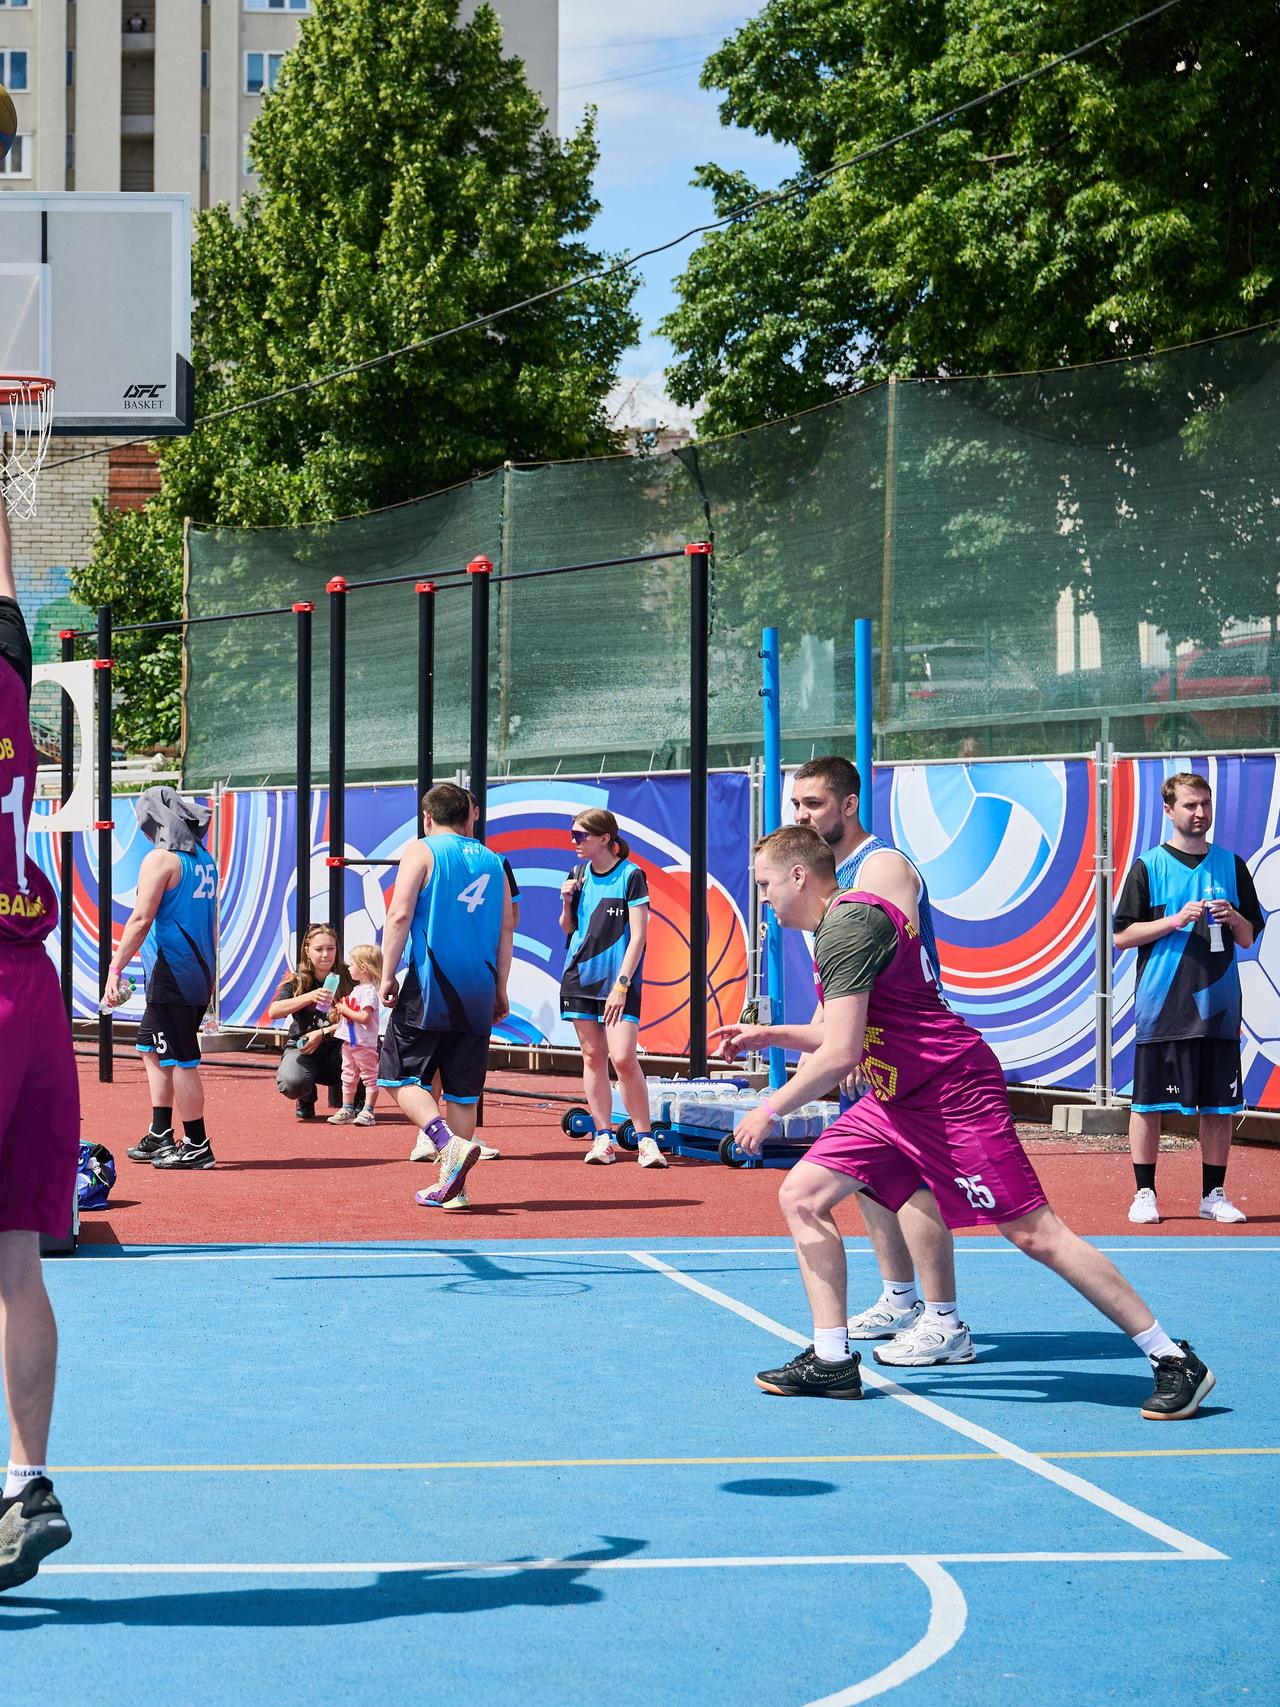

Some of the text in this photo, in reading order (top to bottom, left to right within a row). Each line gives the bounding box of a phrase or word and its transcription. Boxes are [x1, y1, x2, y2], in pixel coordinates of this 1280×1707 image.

[124, 400, 164, 409] BASKET
[192, 864, 215, 899] 25
[457, 873, 491, 913] 4
[953, 1174, 996, 1209] 25
